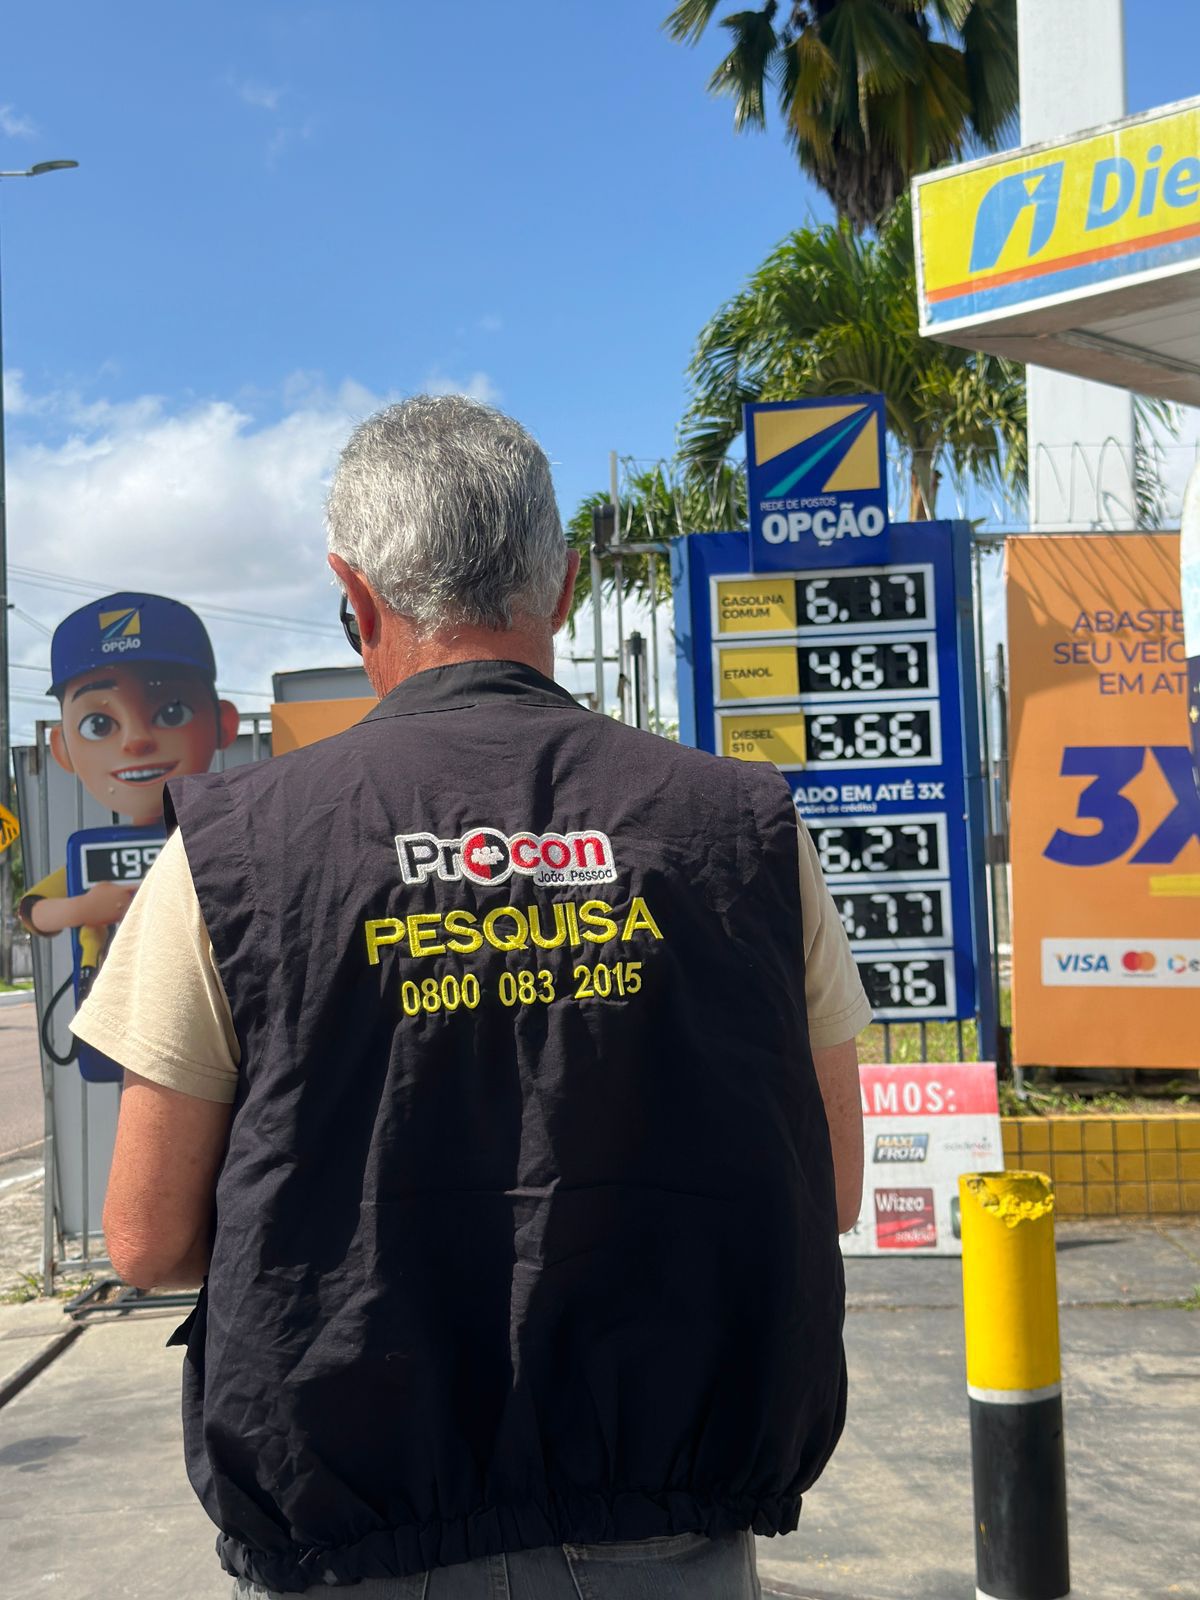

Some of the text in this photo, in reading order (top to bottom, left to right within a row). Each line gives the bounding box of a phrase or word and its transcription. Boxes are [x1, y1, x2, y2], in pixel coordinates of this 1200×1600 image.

[1085, 143, 1200, 233] Die
[760, 497, 837, 511] REDE DE POSTOS
[761, 502, 885, 547] OPÇÃO
[721, 574, 917, 624] GASOLINA 6.17
[722, 607, 770, 619] COMUM
[1072, 609, 1185, 634] ABASTE
[101, 637, 142, 653] OPÇÃO
[1053, 640, 1112, 666] SEU
[723, 644, 919, 691] ETANOL 4.67
[1099, 671, 1187, 696] EM AT
[731, 711, 922, 761] DIESEL 5.66
[732, 742, 754, 753] S10
[841, 784, 872, 801] EM
[875, 779, 915, 801] ATÉ
[917, 782, 945, 800] 3X
[1042, 745, 1200, 867] 3X
[818, 825, 929, 873] 6.27
[538, 869, 613, 883] João Pessoa
[364, 896, 664, 965] PESQUISA
[1055, 953, 1110, 973] VISA
[401, 962, 642, 1016] 0800 083 2015
[877, 1147, 925, 1160] FROTA
